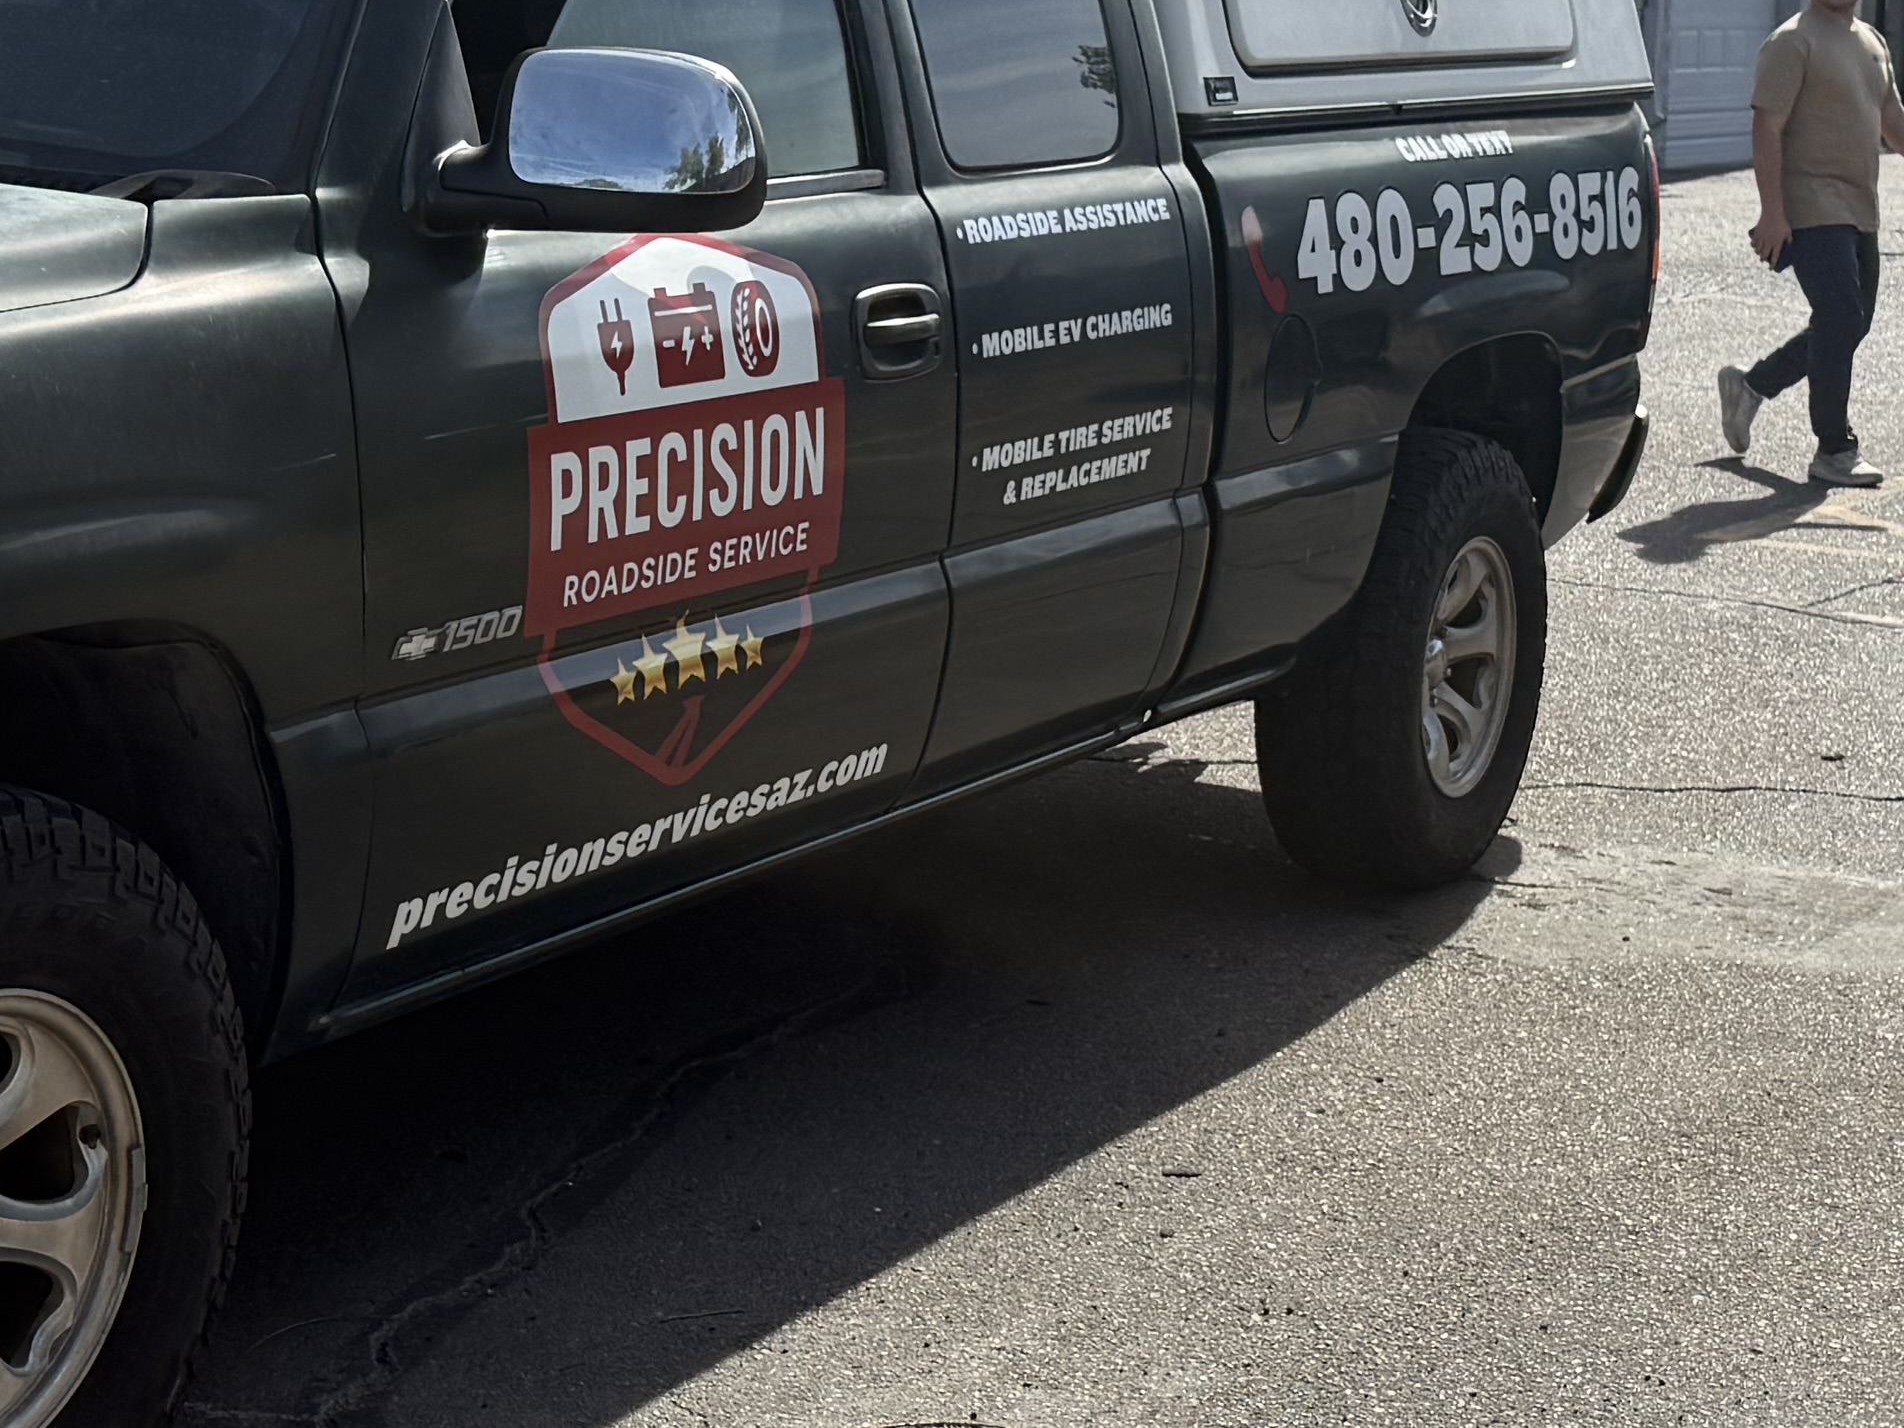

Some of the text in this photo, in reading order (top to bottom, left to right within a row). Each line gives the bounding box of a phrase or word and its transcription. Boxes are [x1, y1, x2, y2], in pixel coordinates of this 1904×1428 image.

[1395, 135, 1448, 162] CALL
[1441, 133, 1473, 159] OR
[963, 198, 1171, 244] ROADSIDE ASSISTANCE
[1296, 166, 1643, 295] 480-256-8516
[981, 303, 1173, 358] MOBILE EV CHARGING
[981, 407, 1174, 472] MOBILE TIRE SERVICE
[549, 406, 826, 552] PRECISION
[1003, 448, 1152, 505] & REPLACEMENT
[562, 521, 810, 608] ROADSIDE SERVICE
[442, 606, 524, 653] 1500
[385, 740, 889, 951] precisionservicesaz.com
